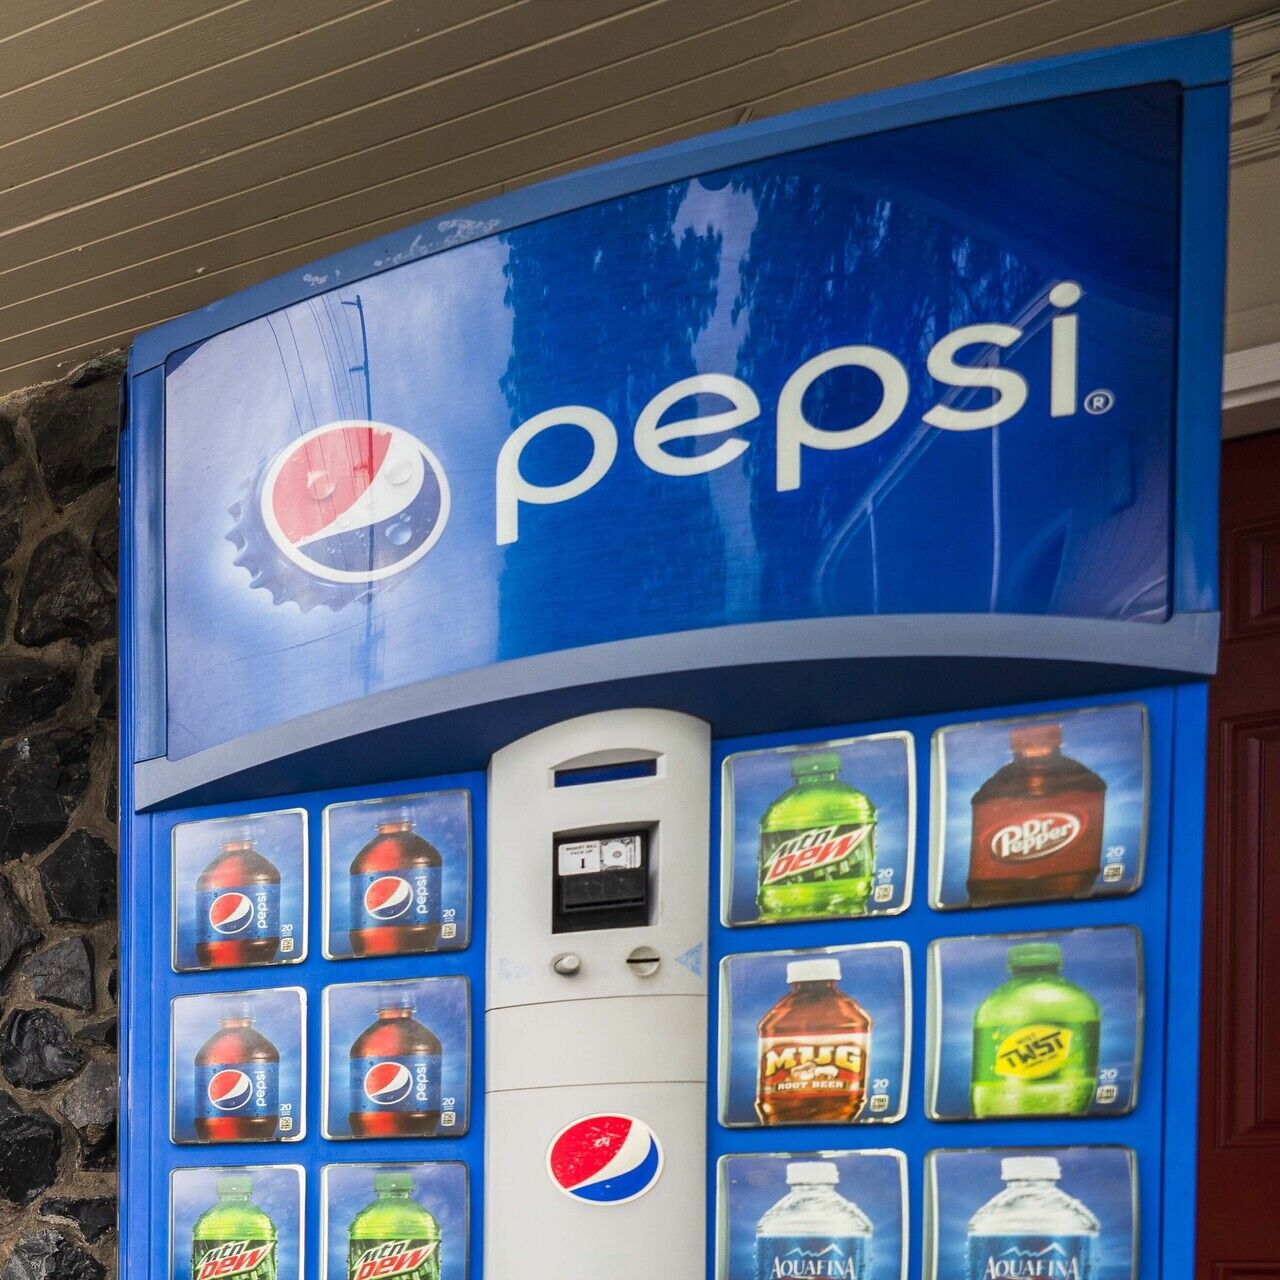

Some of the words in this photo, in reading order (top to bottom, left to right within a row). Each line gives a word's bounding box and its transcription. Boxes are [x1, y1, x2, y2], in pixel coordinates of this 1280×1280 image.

[495, 281, 1080, 545] pepsi
[1001, 822, 1074, 858] Pepper
[1023, 819, 1055, 837] Dr
[415, 876, 428, 914] pepsi
[256, 892, 269, 929] pepsi
[443, 908, 456, 918] 20
[281, 923, 293, 932] 20
[765, 1046, 861, 1077] MUG
[255, 1071, 267, 1107] pepsi
[414, 1063, 428, 1101] pepsi
[778, 1081, 808, 1090] ROOT
[812, 1080, 844, 1089] BEER
[280, 1103, 292, 1111] 20
[443, 1097, 455, 1106] 20
[770, 1256, 856, 1280] AQUAFINA
